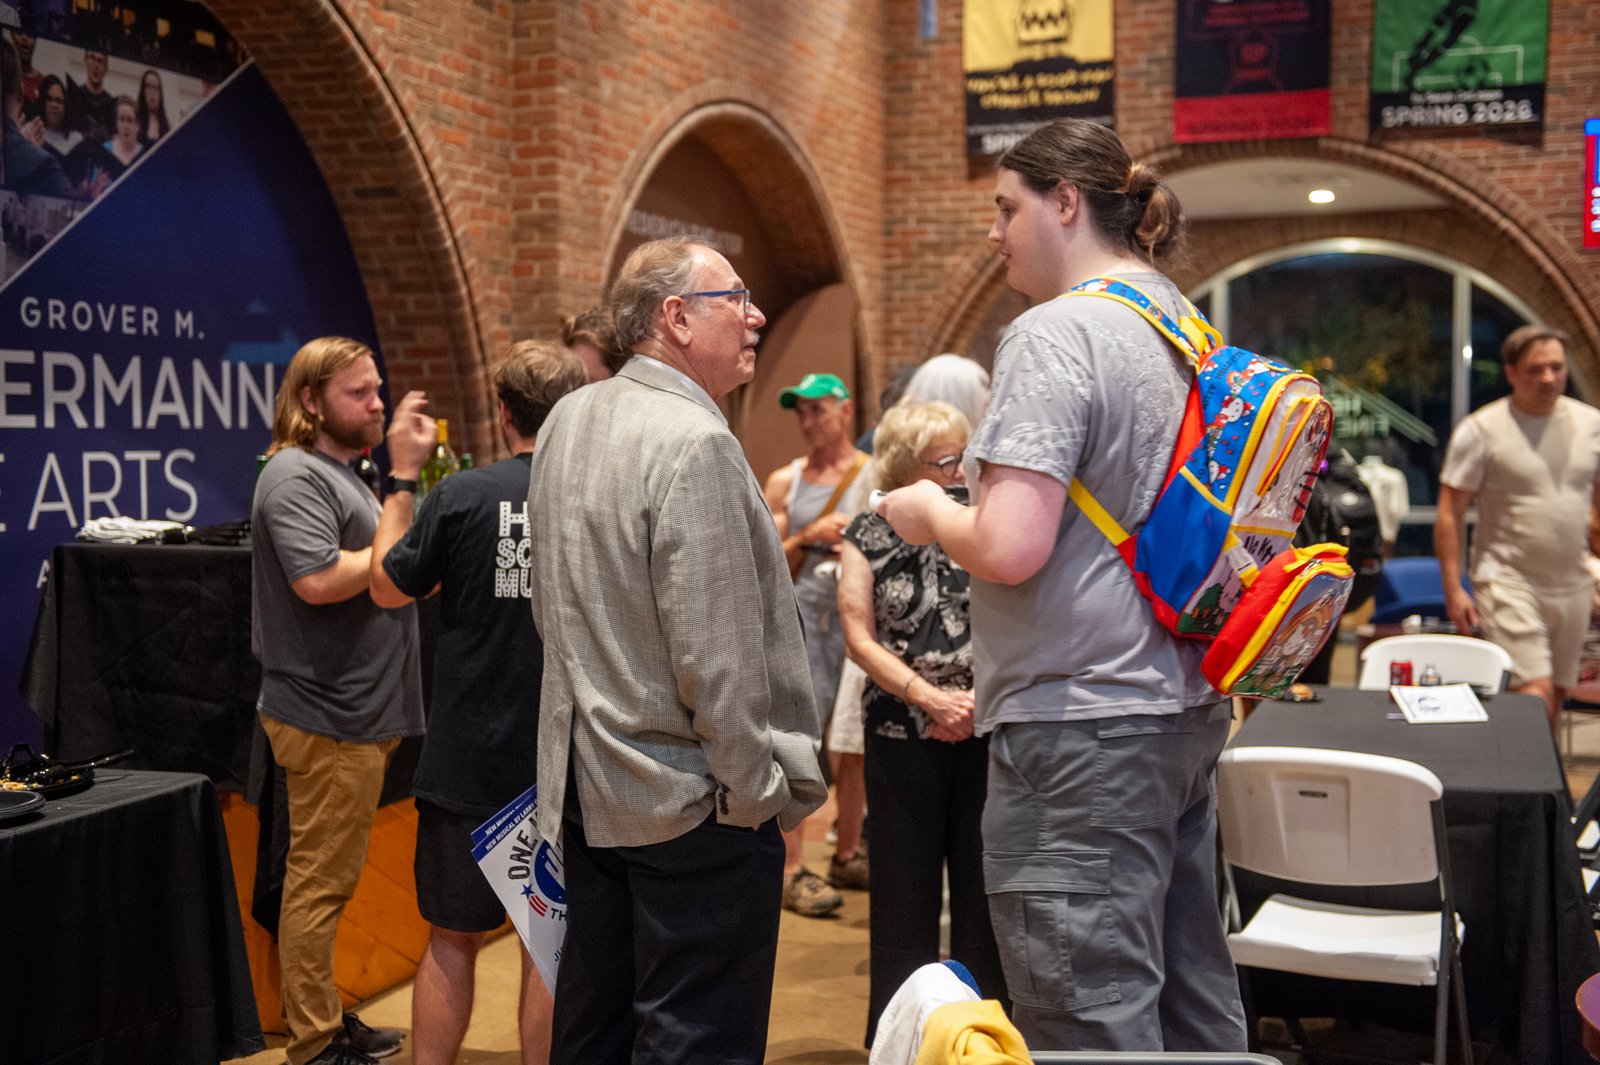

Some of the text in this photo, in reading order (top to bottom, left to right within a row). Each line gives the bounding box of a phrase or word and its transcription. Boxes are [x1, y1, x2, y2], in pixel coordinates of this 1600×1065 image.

[1381, 99, 1533, 128] SPRING 2026
[20, 296, 205, 340] GROVER M.
[27, 449, 199, 531] ARTS
[485, 838, 497, 851] NEW
[495, 821, 516, 841] MUSICAL
[513, 814, 521, 824] BY
[520, 802, 535, 818] LARRY
[508, 829, 538, 880] ONE
